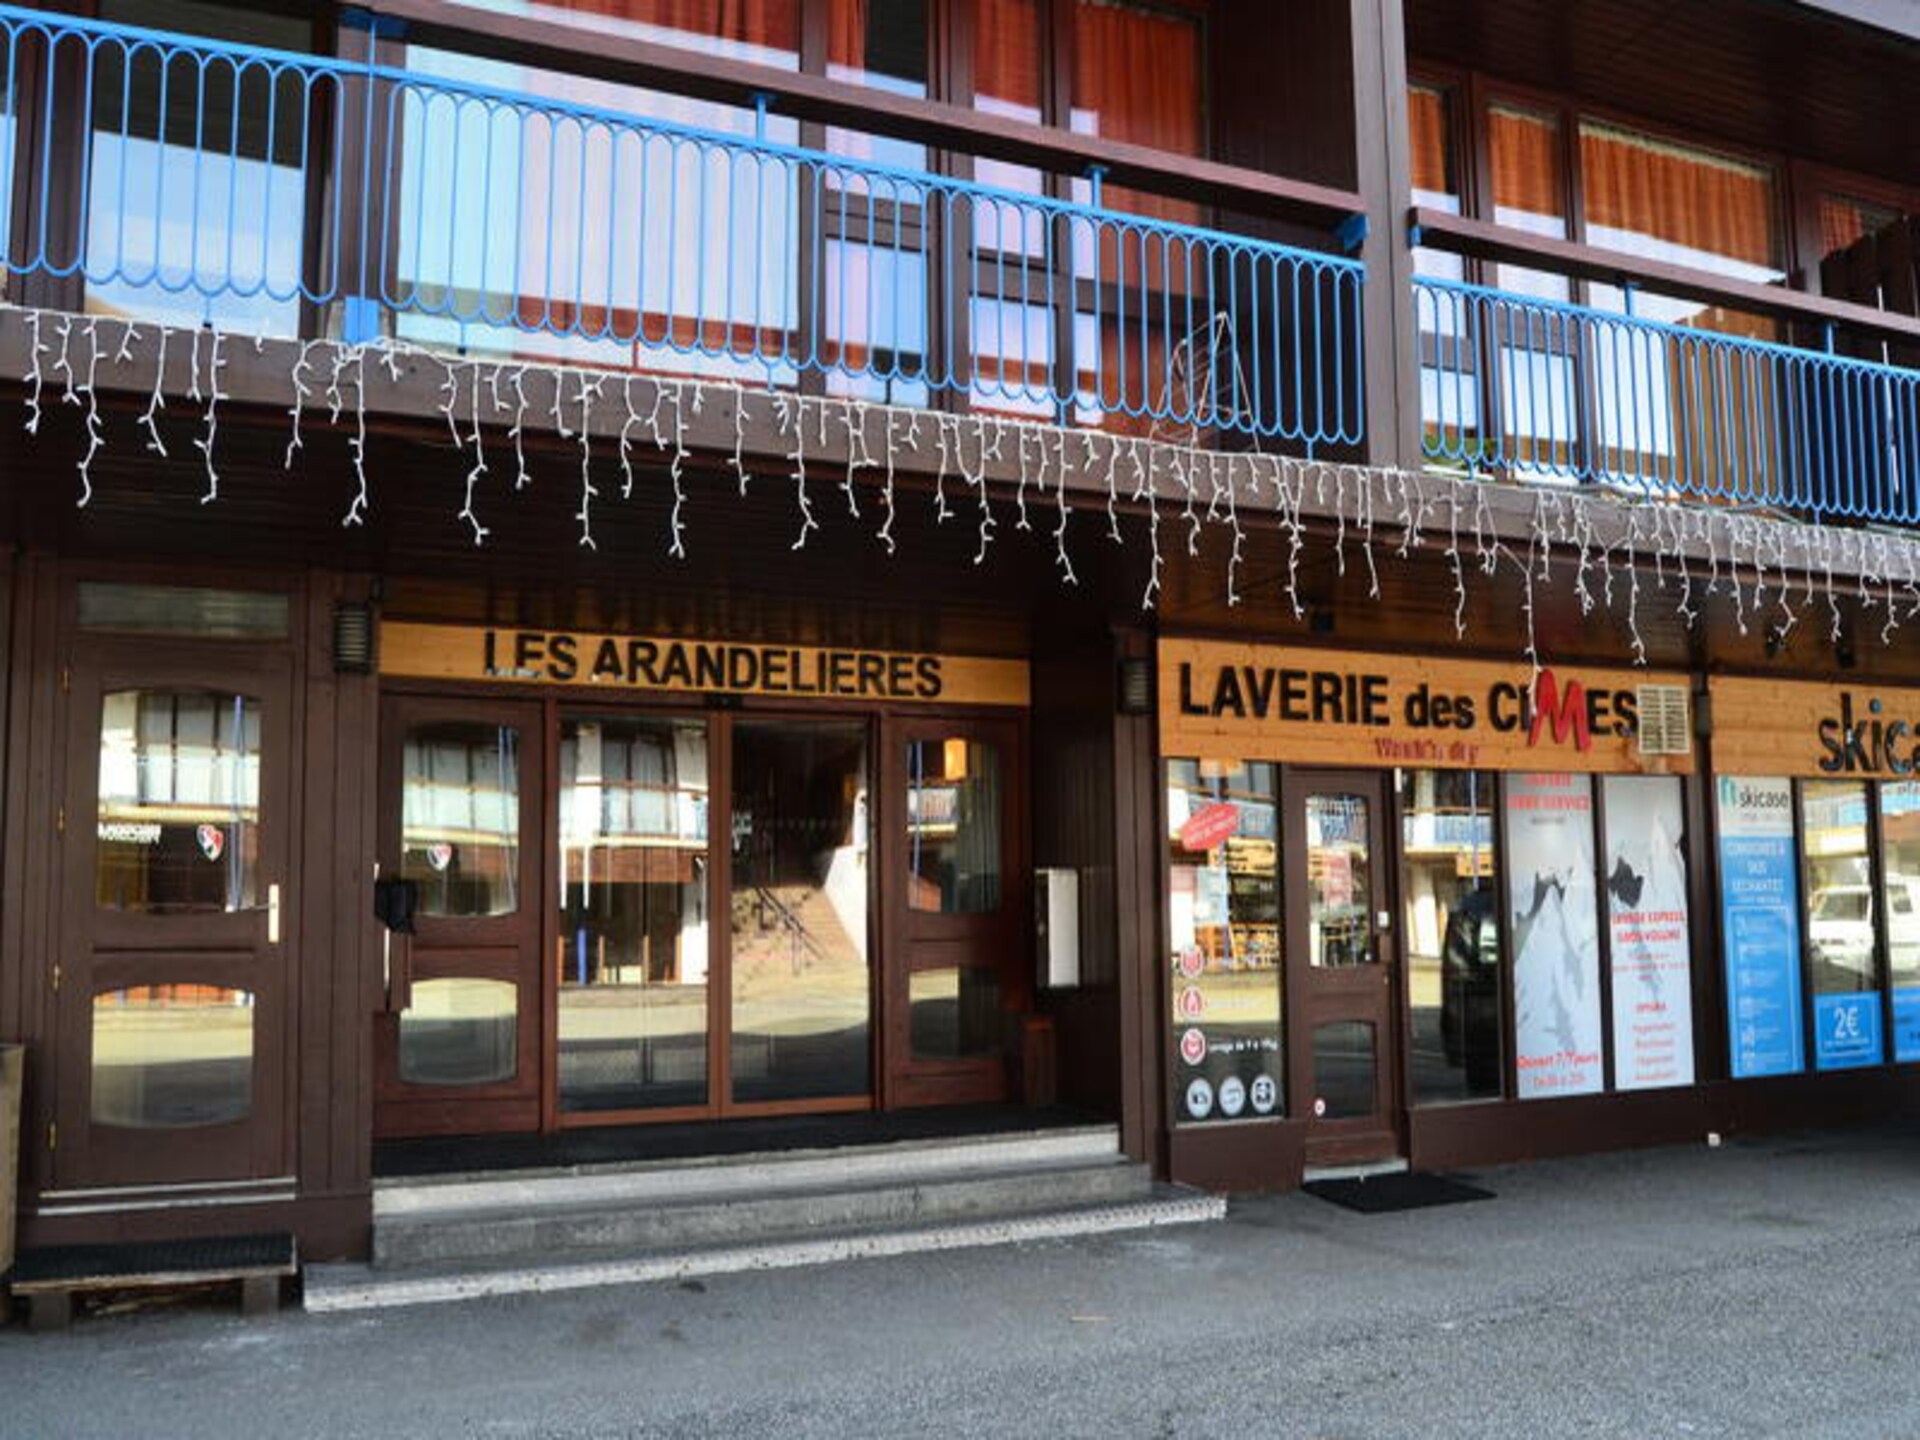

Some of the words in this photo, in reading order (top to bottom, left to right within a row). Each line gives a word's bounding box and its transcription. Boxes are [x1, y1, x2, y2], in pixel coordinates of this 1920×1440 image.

[485, 631, 577, 680] LES
[592, 637, 942, 698] ARANDELIERES
[1179, 662, 1390, 726] LAVERIE
[1404, 683, 1476, 729] des
[1489, 668, 1638, 752] CIMES
[1833, 1007, 1860, 1038] 2€
